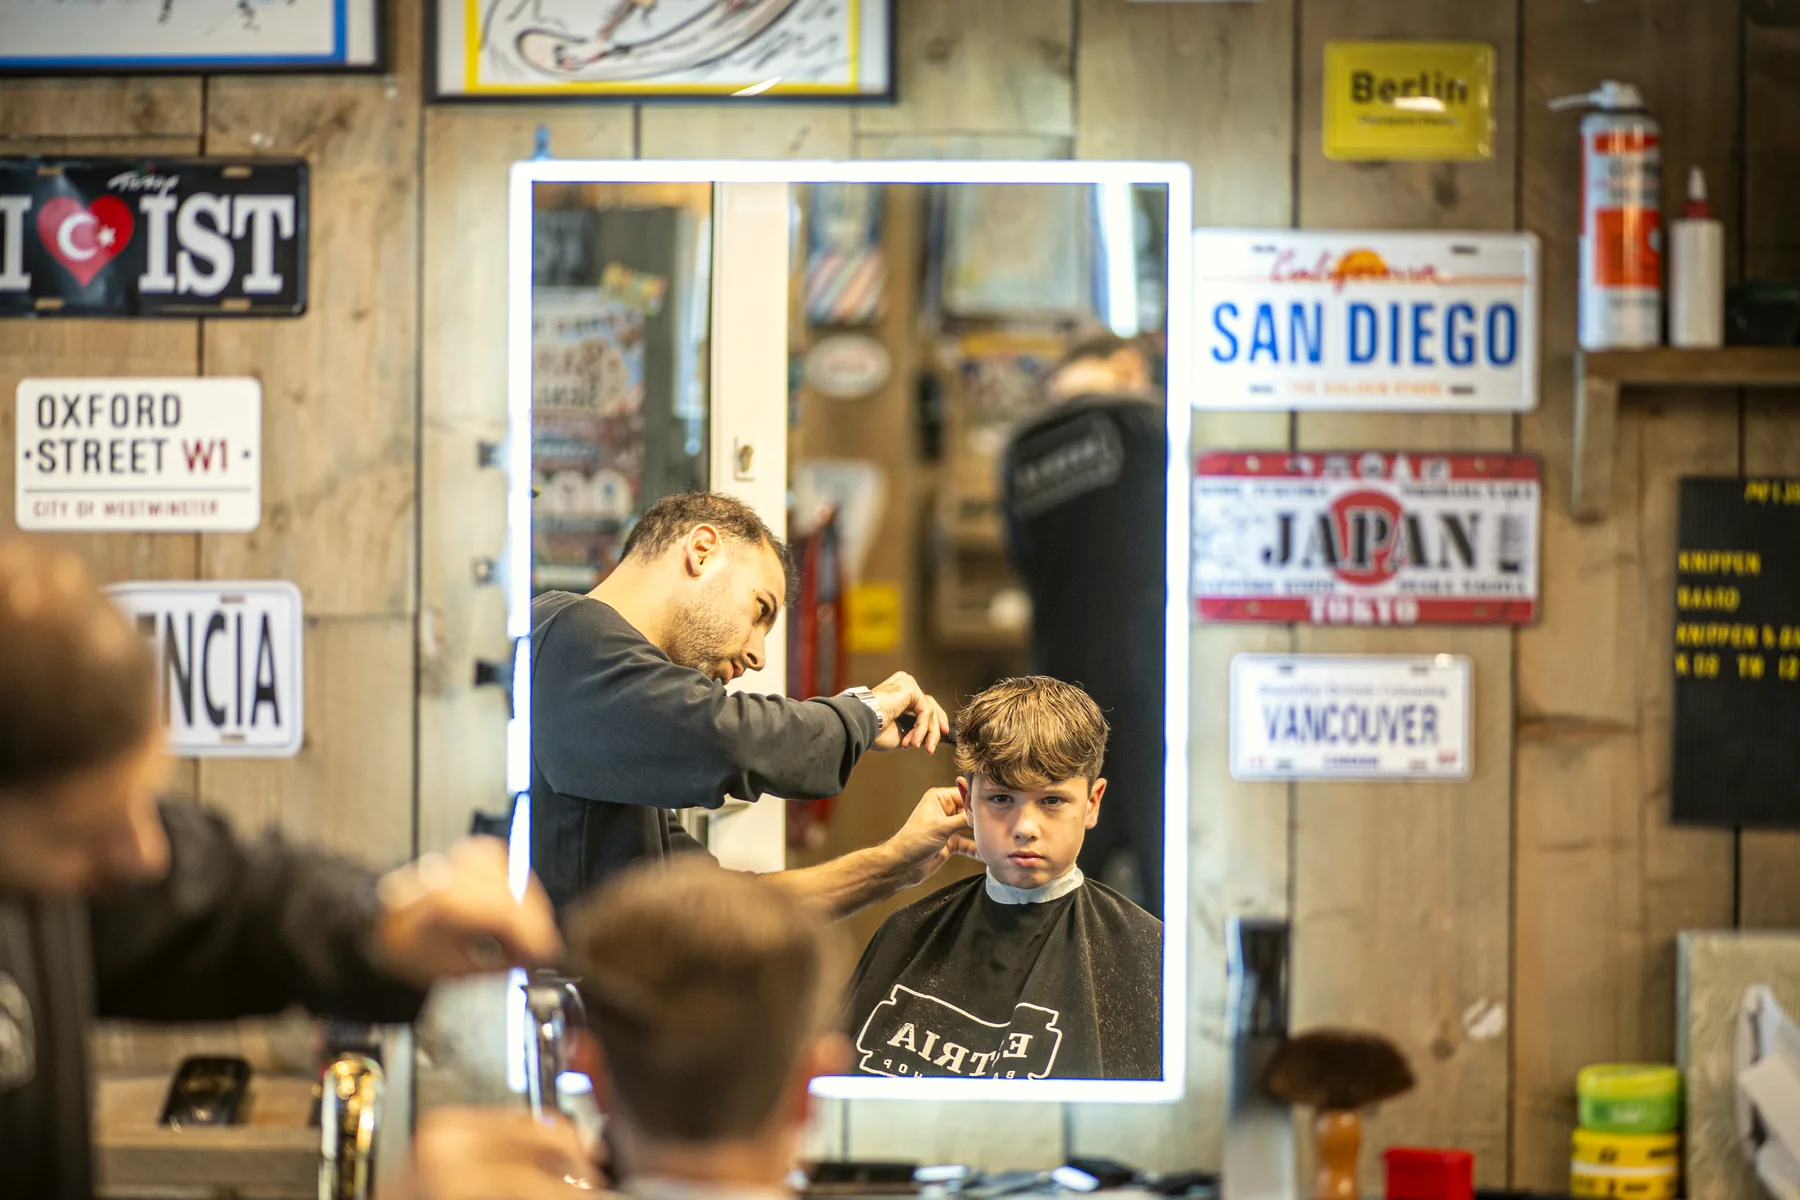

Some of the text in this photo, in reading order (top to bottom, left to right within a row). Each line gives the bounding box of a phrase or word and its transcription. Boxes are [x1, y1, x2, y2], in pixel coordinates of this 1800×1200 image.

[1352, 70, 1468, 104] Berlin
[1211, 302, 1518, 367] SAN DIEGO
[37, 393, 182, 430] OXFORD
[36, 438, 229, 474] STREET W1
[1262, 506, 1480, 573] JAPAN
[1308, 597, 1419, 623] TOKYO
[137, 612, 280, 728] NCIA
[1262, 704, 1440, 747] VANCOUVER
